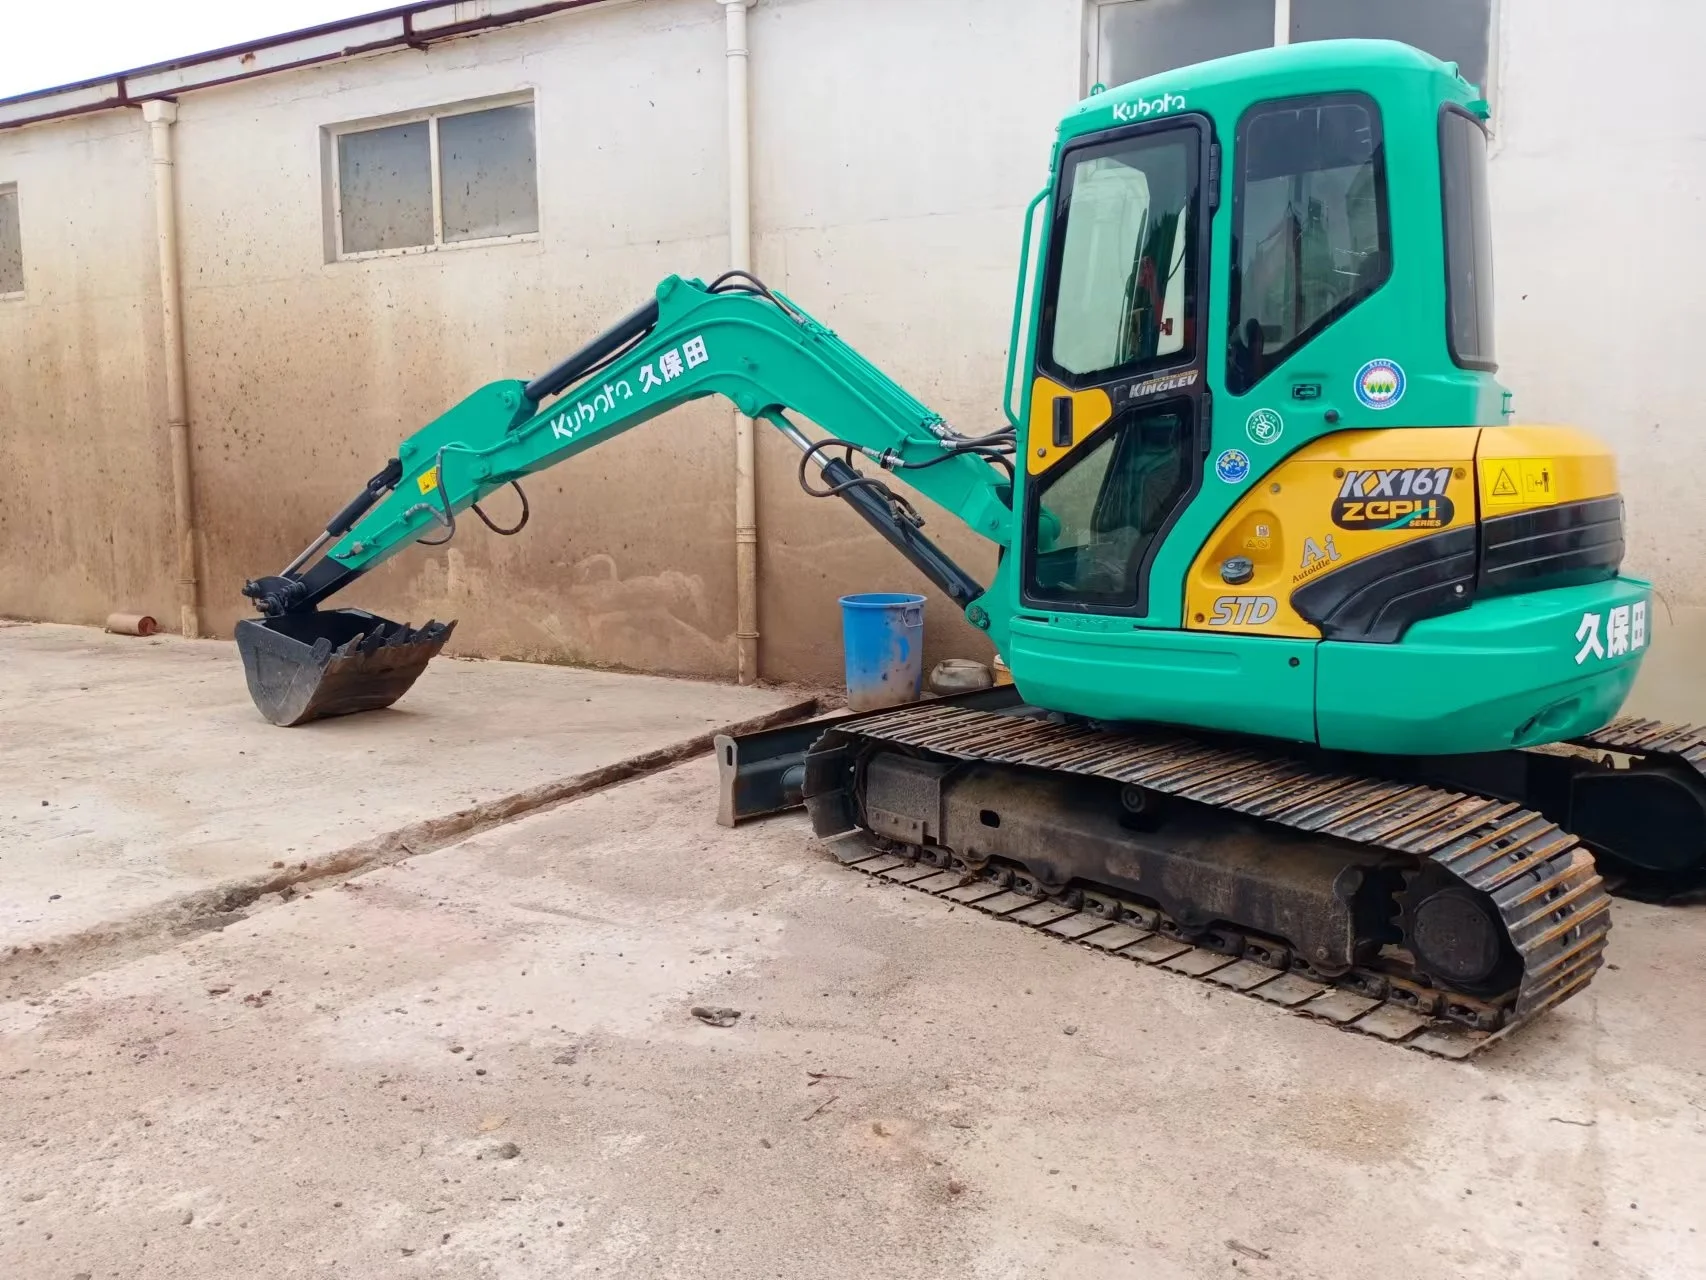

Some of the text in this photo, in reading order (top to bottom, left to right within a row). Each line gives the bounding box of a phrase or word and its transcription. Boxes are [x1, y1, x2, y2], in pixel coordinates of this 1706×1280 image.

[1113, 93, 1186, 121] Kubota
[551, 335, 709, 439] Kubota 久保田
[1339, 467, 1453, 498] KX161
[1409, 519, 1442, 527] SERIES
[1301, 534, 1342, 568] Ai
[1208, 595, 1278, 626] STD
[1573, 600, 1646, 665] 久保田
